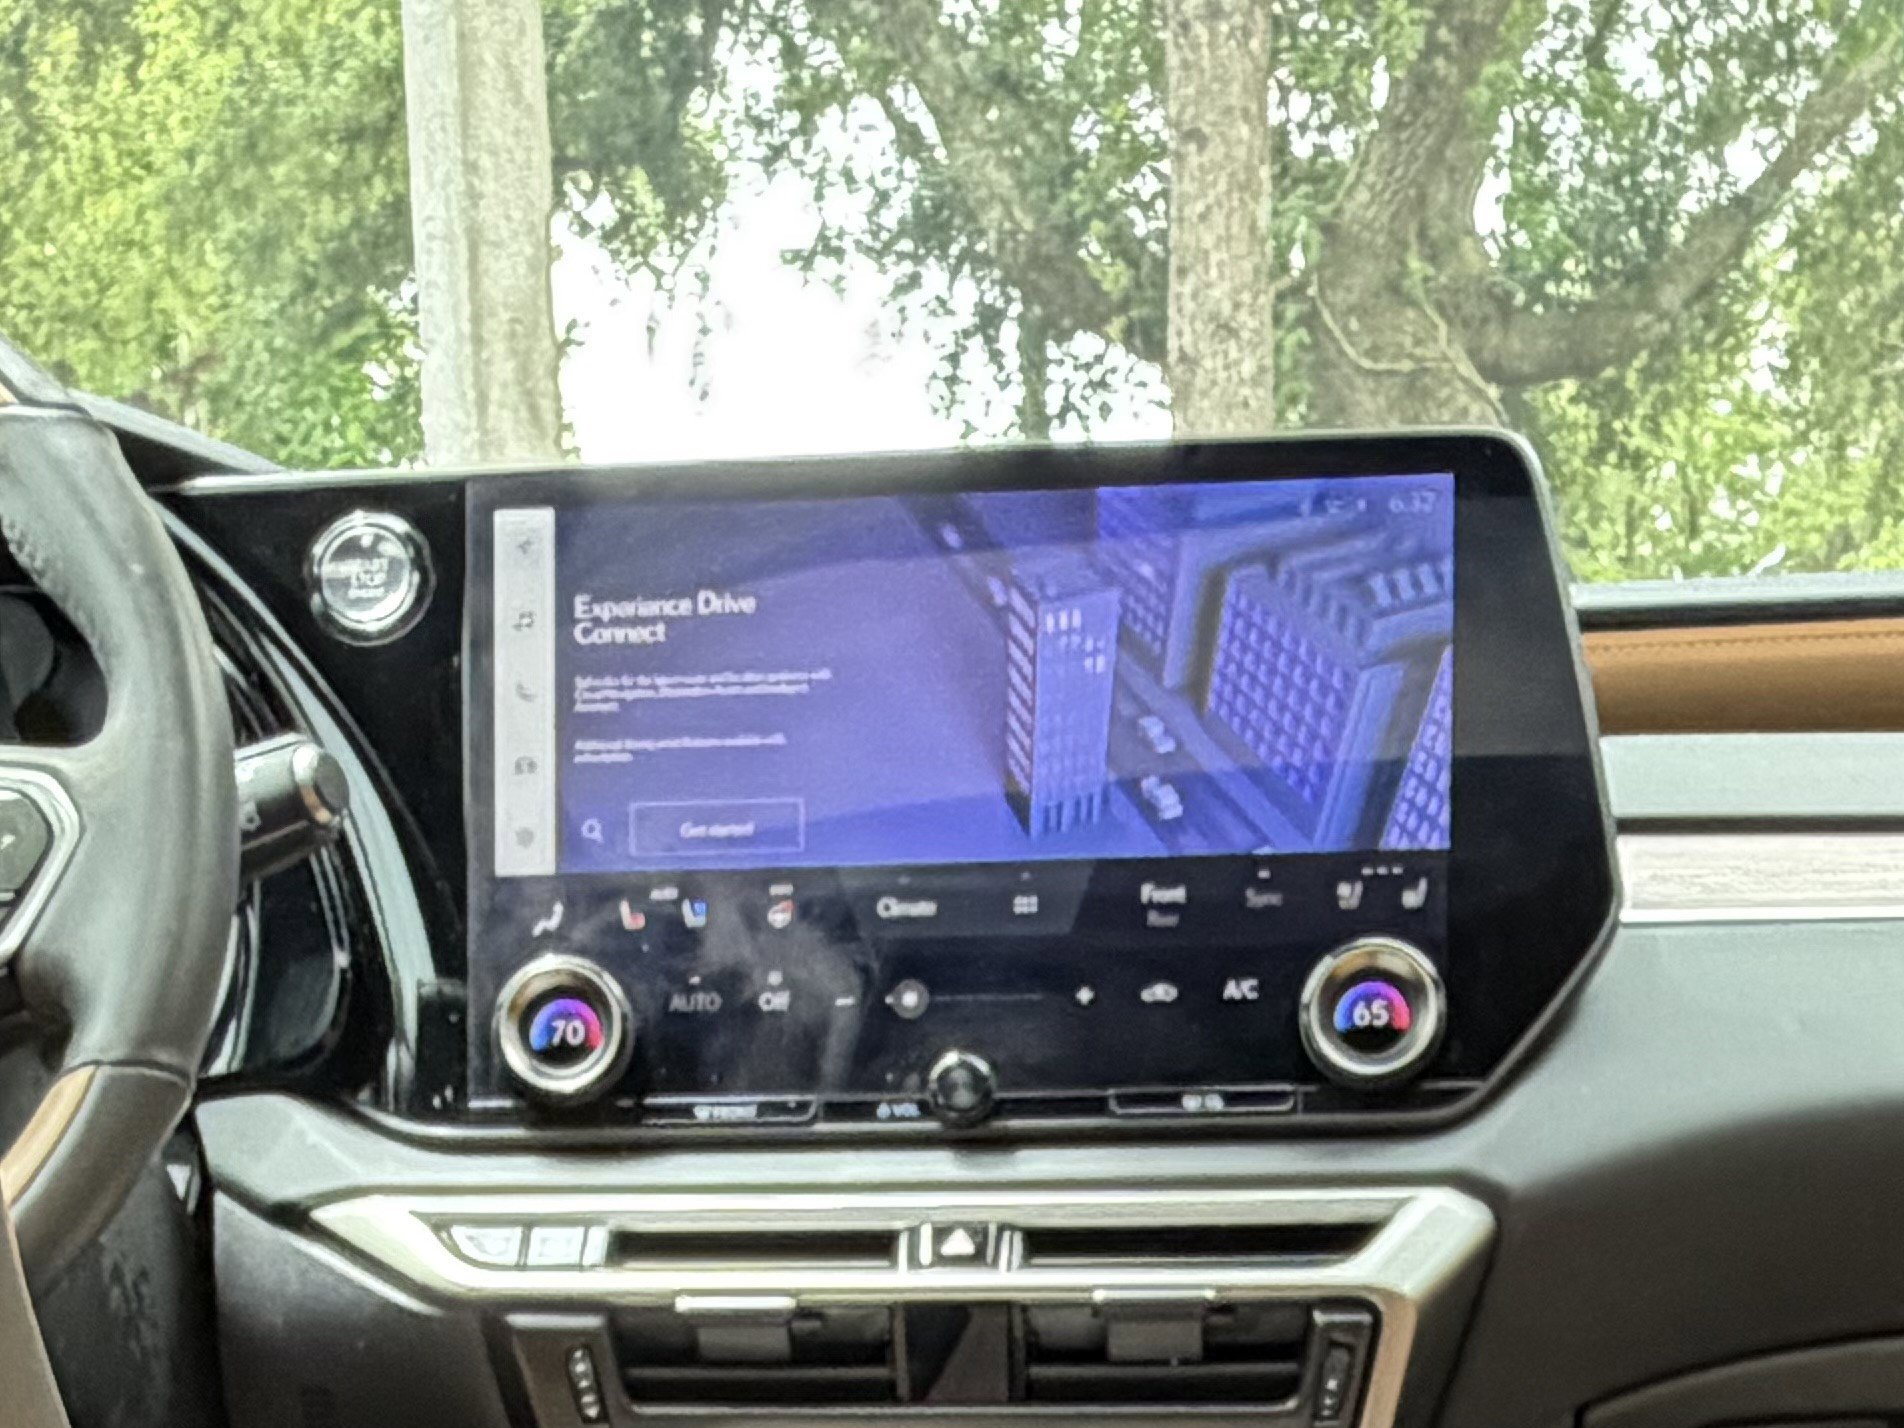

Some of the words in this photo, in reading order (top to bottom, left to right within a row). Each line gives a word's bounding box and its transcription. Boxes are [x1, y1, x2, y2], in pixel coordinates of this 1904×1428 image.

[573, 593, 693, 621] Experience
[697, 588, 757, 616] Drive
[573, 620, 666, 646] Connect
[1140, 881, 1187, 905] Front
[1222, 977, 1260, 1001] A/C
[668, 992, 724, 1013] AUTO
[1352, 998, 1390, 1028] 65
[551, 1019, 586, 1047] 70
